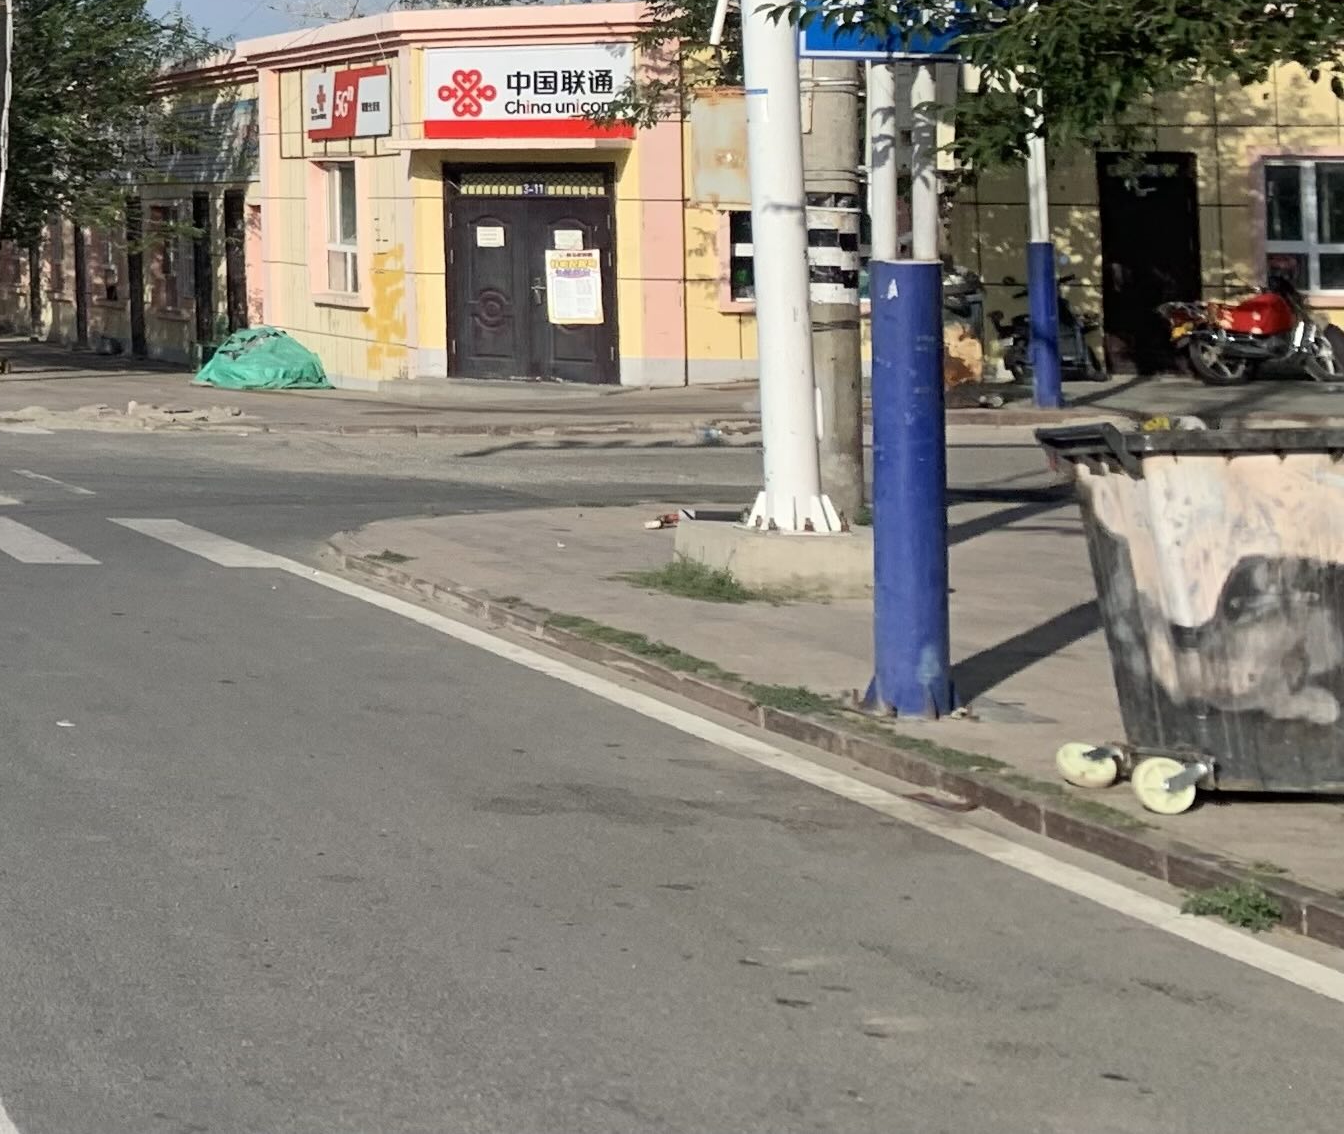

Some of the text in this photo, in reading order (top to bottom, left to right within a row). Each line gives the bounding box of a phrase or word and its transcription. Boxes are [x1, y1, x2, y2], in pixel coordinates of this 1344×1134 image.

[506, 69, 613, 96] 中国联通
[504, 99, 551, 115] China
[523, 183, 544, 195] 3-11
